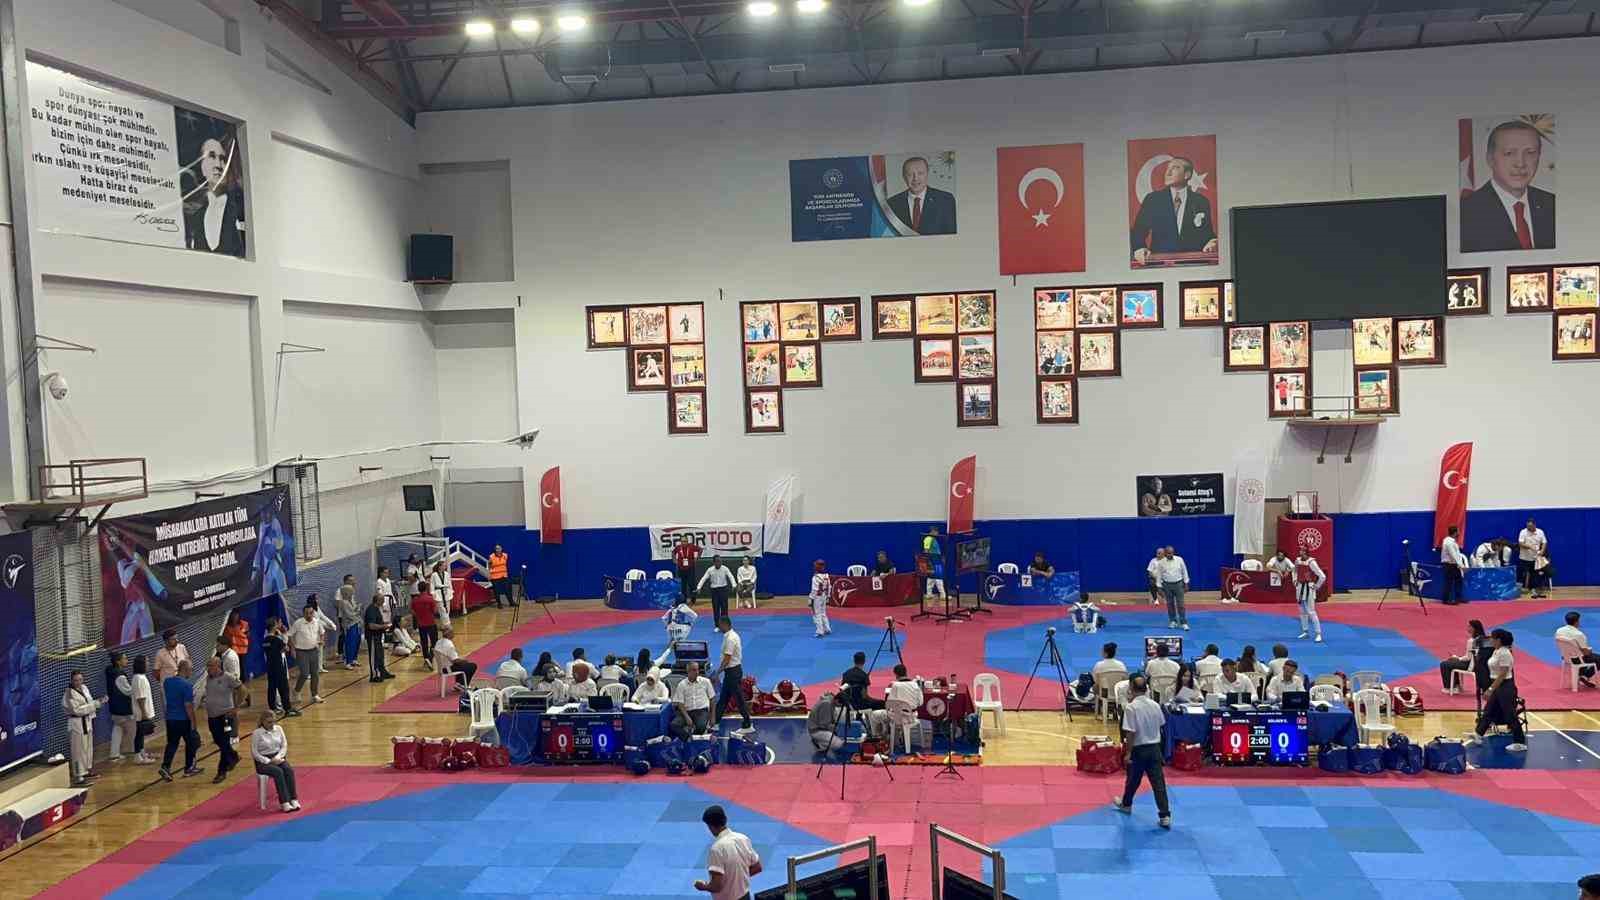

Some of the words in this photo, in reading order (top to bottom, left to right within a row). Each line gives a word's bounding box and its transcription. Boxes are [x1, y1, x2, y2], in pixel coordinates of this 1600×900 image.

[45, 99, 64, 111] spor
[120, 119, 158, 136] mühimdir.
[136, 111, 144, 120] ve
[31, 107, 44, 120] Bu
[46, 111, 73, 127] kadar
[75, 120, 104, 135] mühim
[106, 127, 123, 140] olan
[125, 134, 142, 144] spor
[51, 126, 75, 142] bizim
[77, 132, 94, 147] için
[96, 138, 116, 152] daha
[119, 144, 157, 161] mühimdir.
[60, 142, 87, 158] Çünkü
[90, 150, 101, 161] ırk
[82, 163, 93, 173] ve
[80, 174, 104, 189] Hatta
[106, 180, 127, 193] biraz
[129, 183, 138, 195] da
[62, 187, 107, 203] medeniyet
[109, 195, 156, 210] meselesidir.
[155, 516, 208, 541] MÜSABAKALARA
[208, 511, 234, 529] KATILAN
[233, 506, 248, 522] TÜM
[177, 535, 210, 559] ANTRENÖR
[210, 534, 219, 550] VE
[219, 526, 257, 548] SPORCULARA
[174, 557, 210, 583] BAŞARILAR
[210, 549, 238, 571] DİLERİM.
[1272, 576, 1279, 584] 7
[558, 734, 568, 748] 0
[575, 737, 591, 745] 2:00
[598, 734, 607, 748] 0
[1230, 732, 1241, 748] 0
[1250, 736, 1269, 745] 2:00
[1278, 732, 1289, 748] 0
[53, 805, 63, 822] 3
